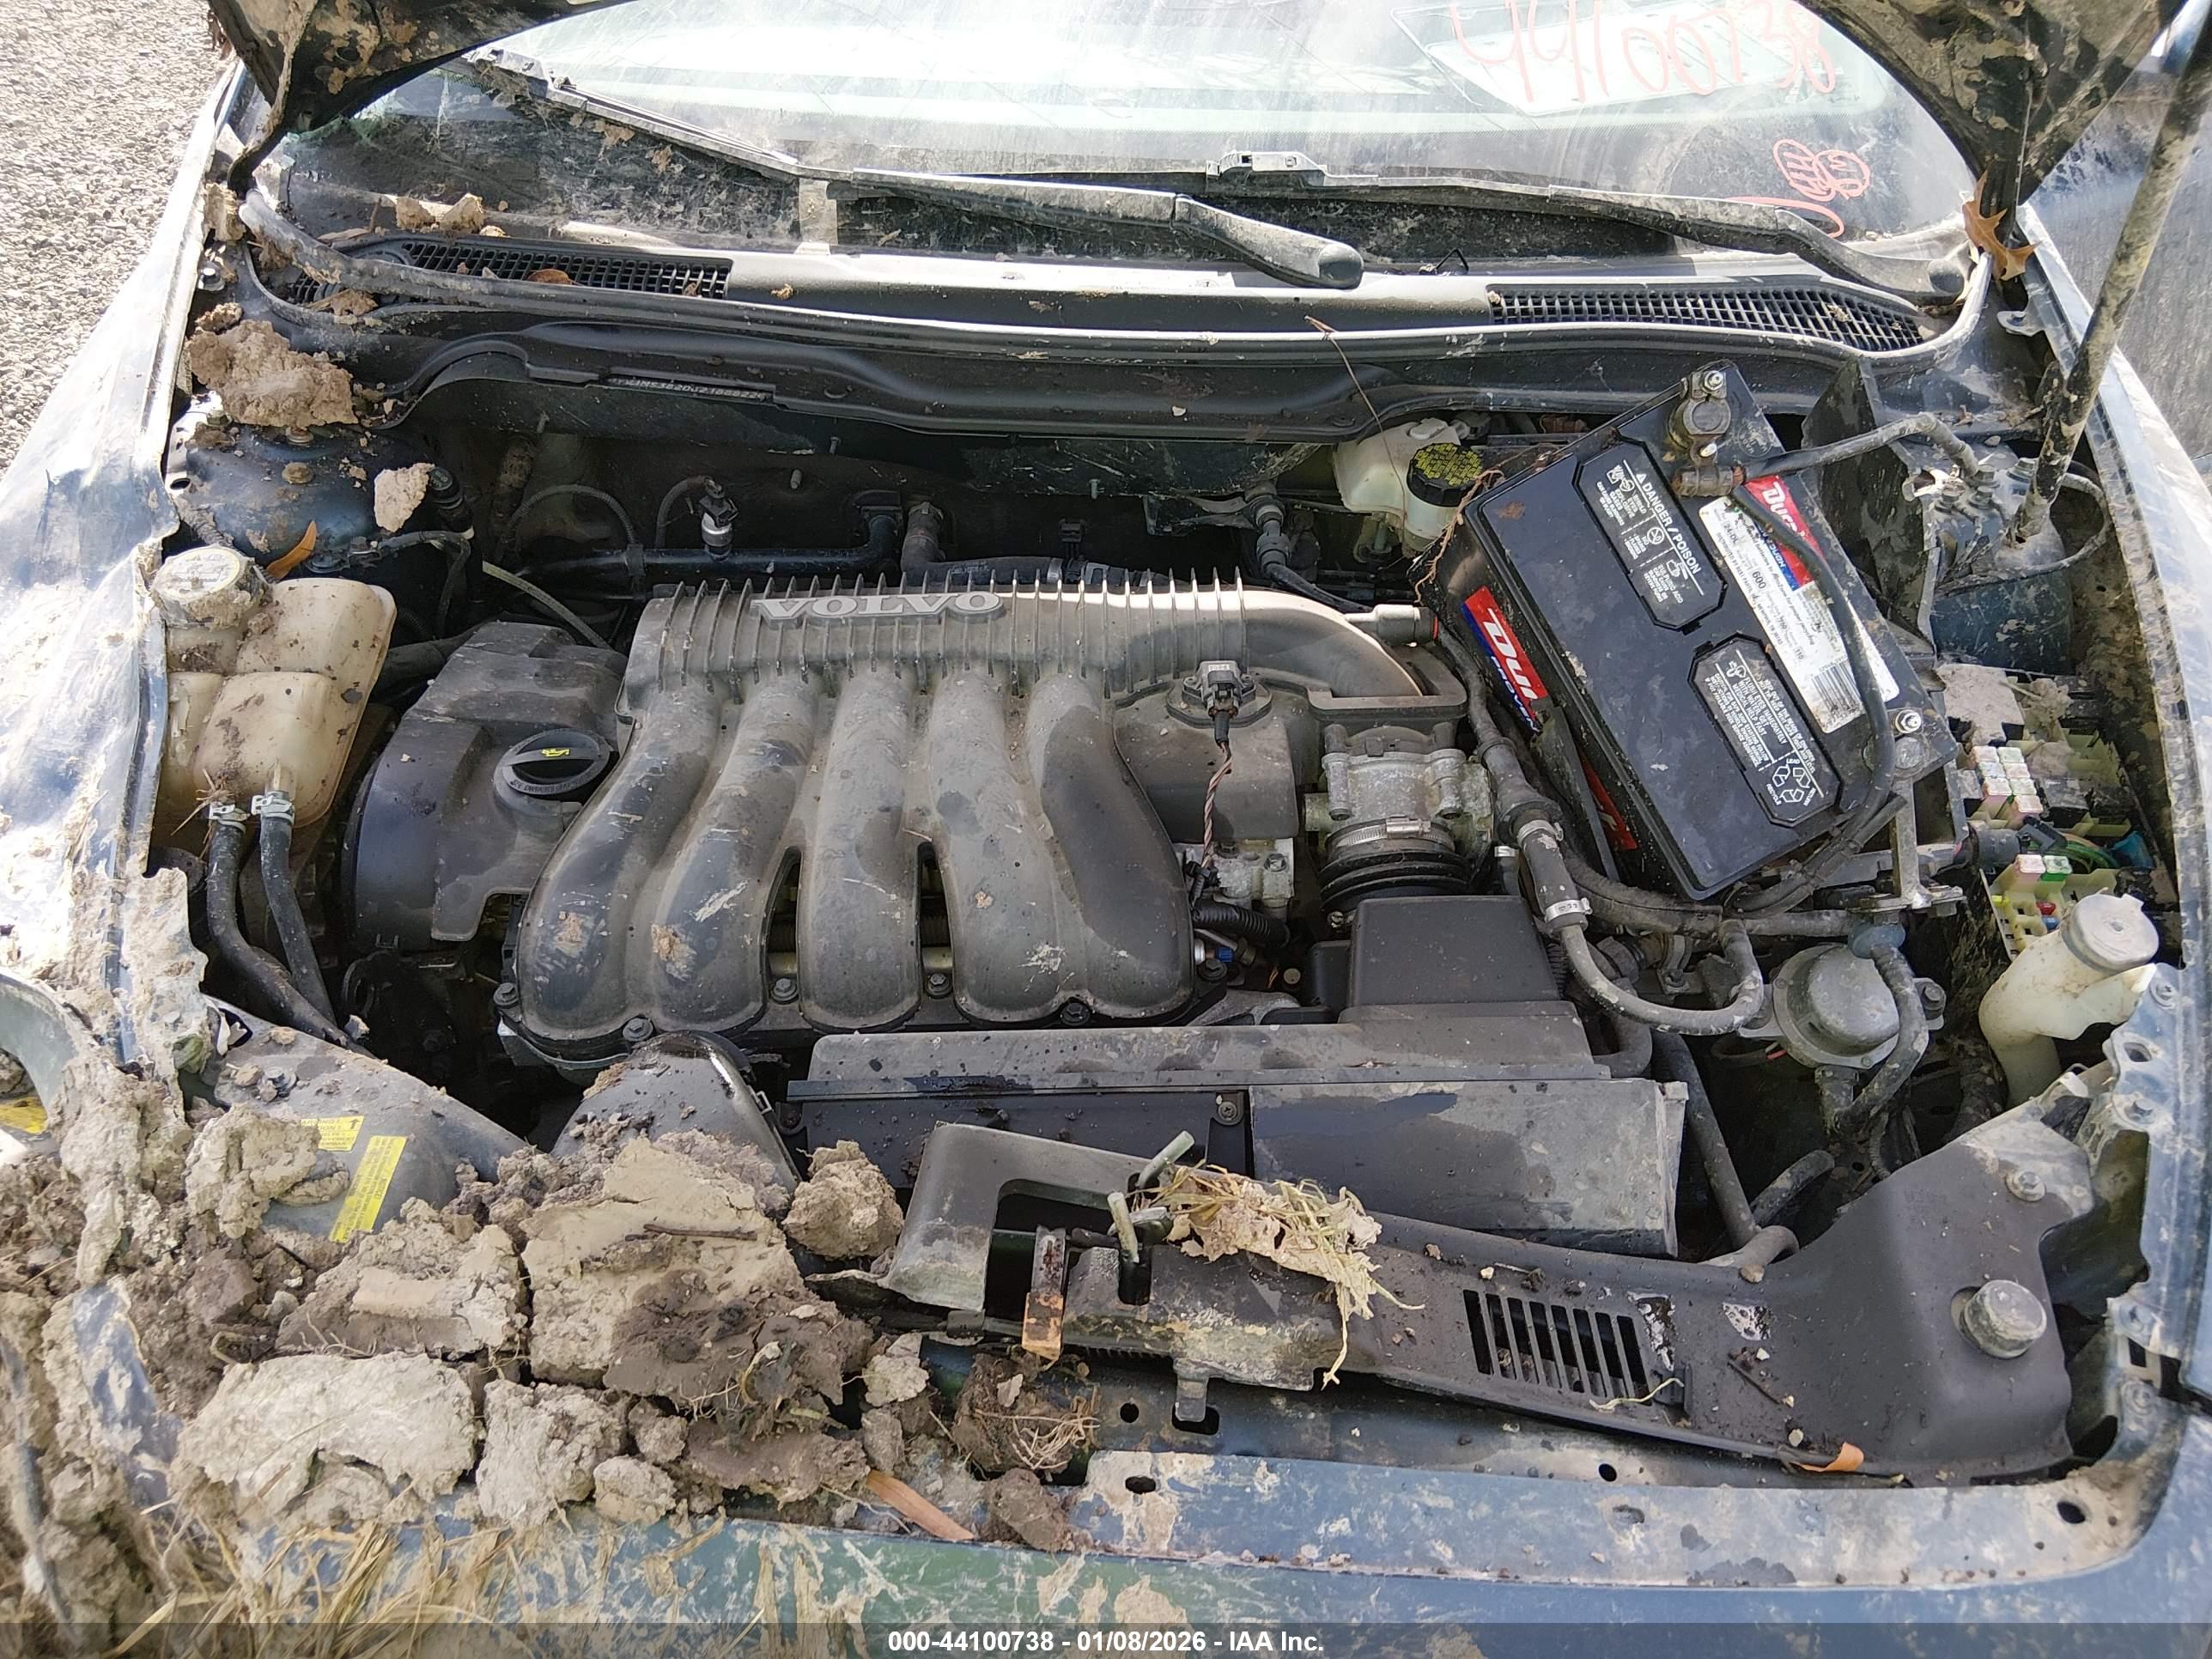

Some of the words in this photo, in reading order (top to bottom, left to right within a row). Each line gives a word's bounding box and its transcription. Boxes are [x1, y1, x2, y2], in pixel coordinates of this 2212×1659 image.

[1641, 481, 1673, 527] DANGER
[1672, 532, 1701, 574] POISON
[1750, 570, 1766, 590] 600
[752, 591, 1004, 623] VOLVO
[1672, 589, 1684, 604] ACID
[1731, 683, 1748, 708] MEDICAL
[1745, 707, 1758, 723] HELP
[1736, 680, 1749, 696] WITH
[1742, 676, 1758, 696] FLUSH
[1753, 694, 1766, 711] EYES
[1762, 708, 1787, 744] IMMEDIATELY
